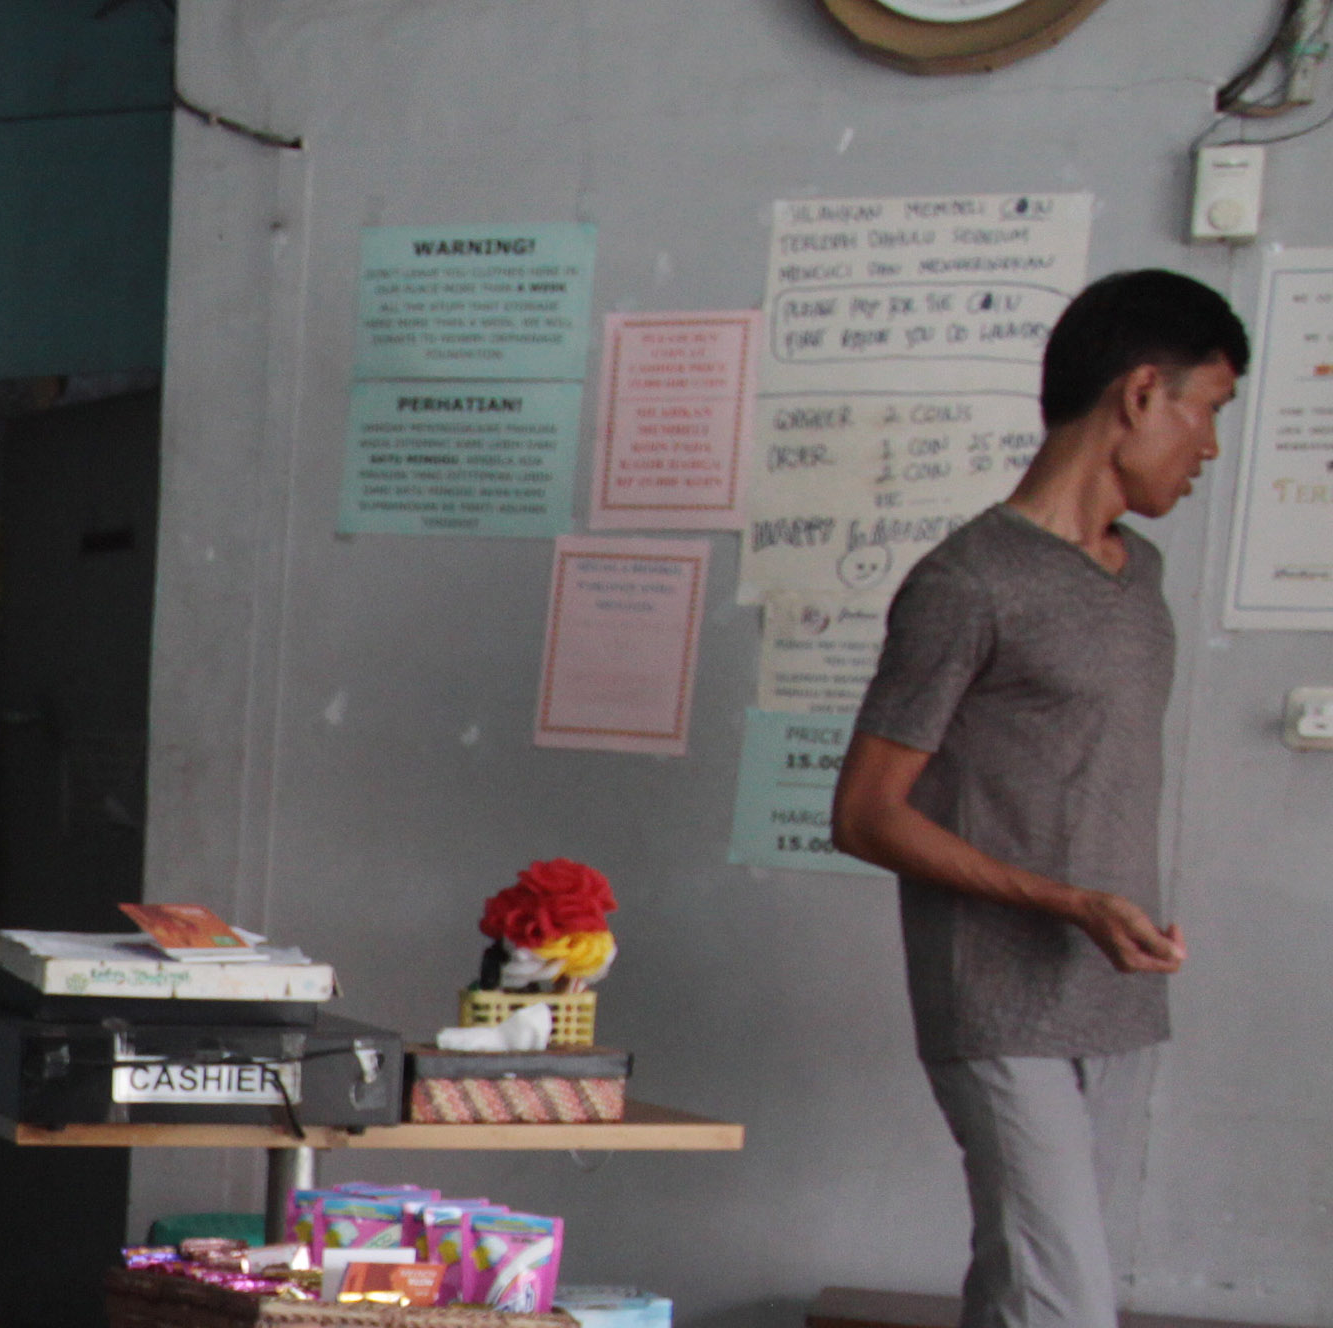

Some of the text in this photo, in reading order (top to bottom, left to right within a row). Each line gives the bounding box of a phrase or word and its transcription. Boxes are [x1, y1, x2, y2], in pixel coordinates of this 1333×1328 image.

[412, 238, 535, 256] WARNING!
[397, 397, 522, 412] PERHATIAN!
[787, 726, 842, 744] PRICE
[129, 1064, 283, 1092] CASHIER
